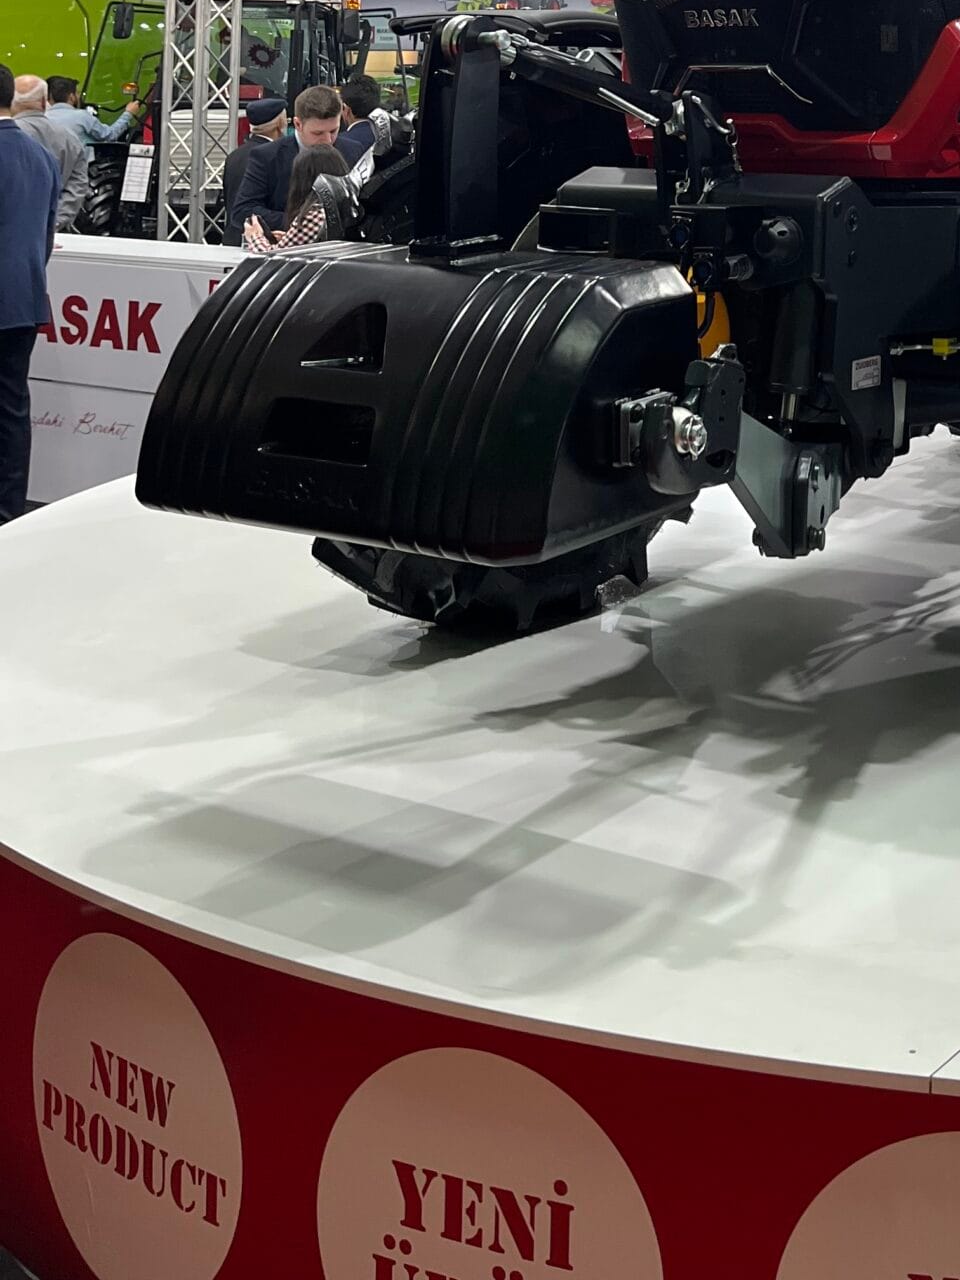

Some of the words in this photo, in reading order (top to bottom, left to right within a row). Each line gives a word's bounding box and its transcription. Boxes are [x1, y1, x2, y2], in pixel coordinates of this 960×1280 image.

[683, 8, 760, 29] BASAK
[89, 1040, 176, 1129] NEW
[42, 1078, 227, 1228] PRODUCT
[391, 1159, 575, 1271] YENİ
